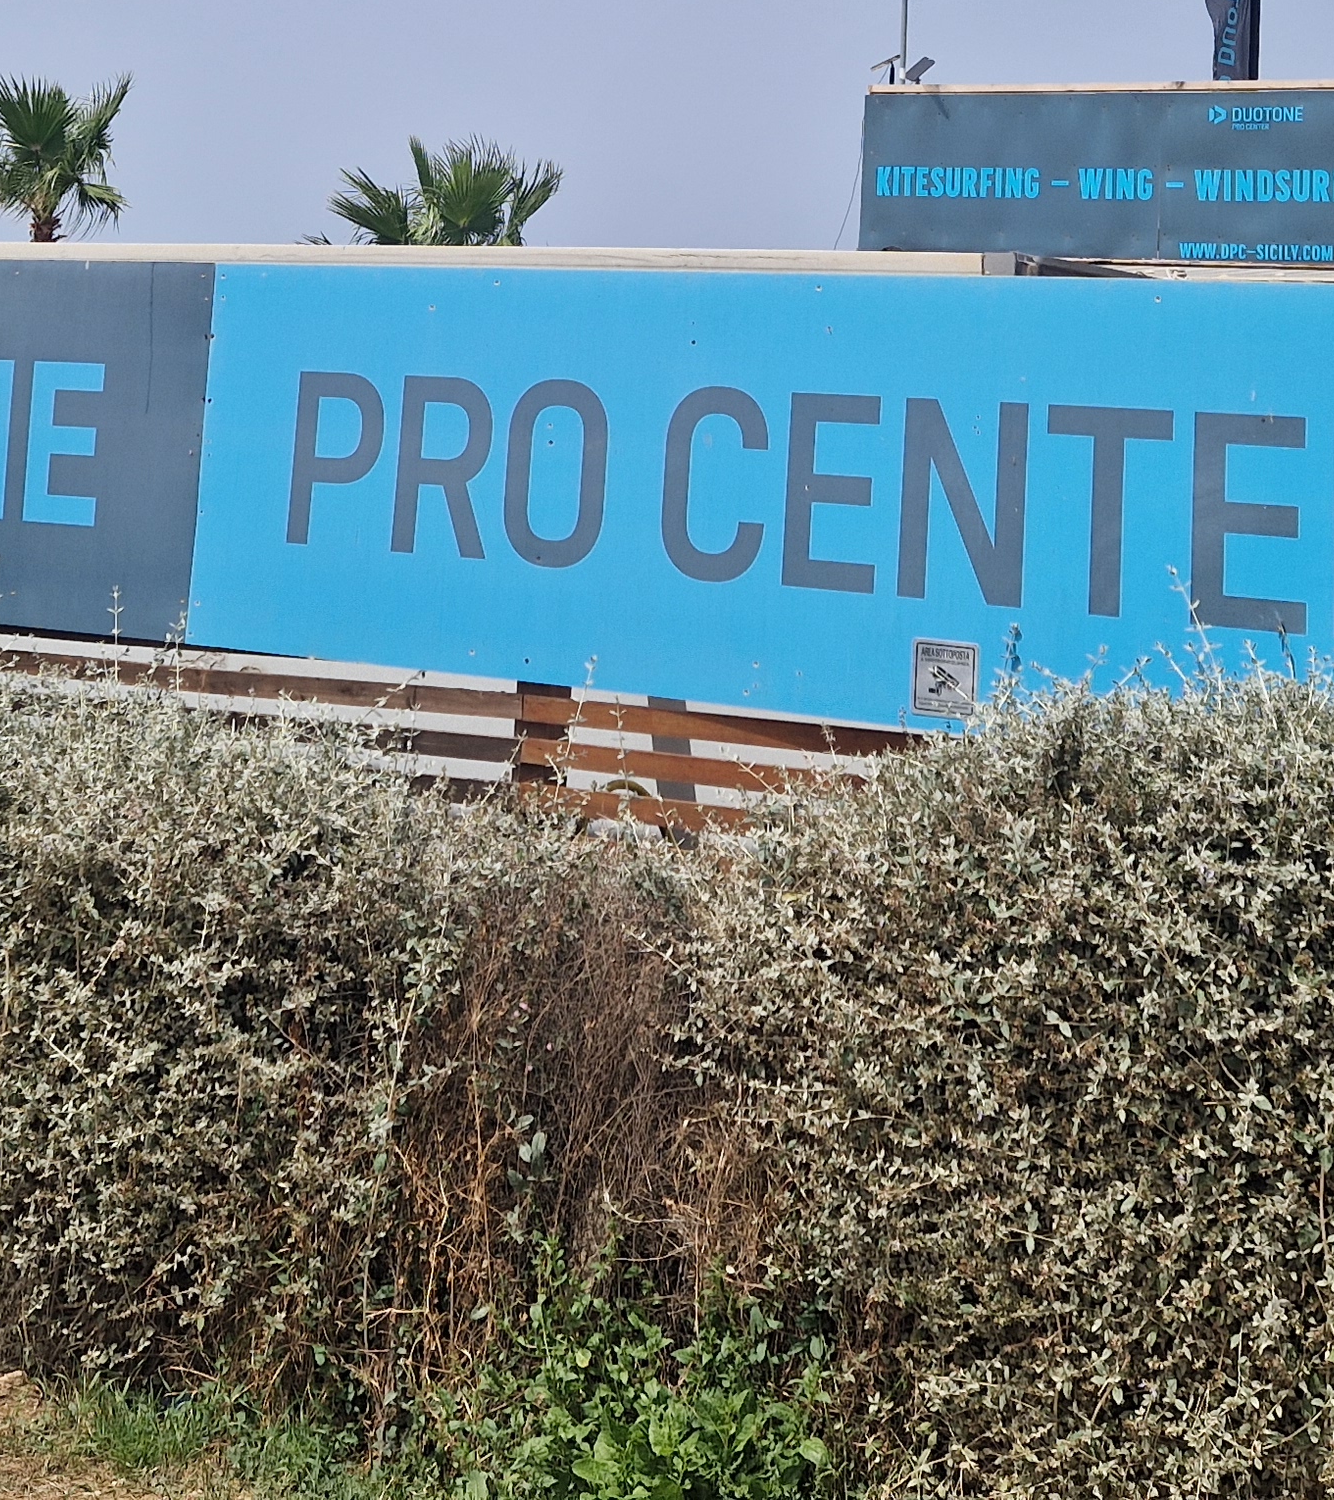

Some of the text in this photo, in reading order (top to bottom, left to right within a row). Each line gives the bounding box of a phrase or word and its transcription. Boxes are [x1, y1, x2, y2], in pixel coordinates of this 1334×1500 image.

[1231, 106, 1304, 122] DUOTONE
[1231, 123, 1270, 131] PRO CENTER
[875, 166, 1041, 199] KITESURFING
[1078, 167, 1155, 201] WING
[1178, 241, 1334, 262] WWW.DPC-SICILY.COM
[287, 371, 609, 569] PRO
